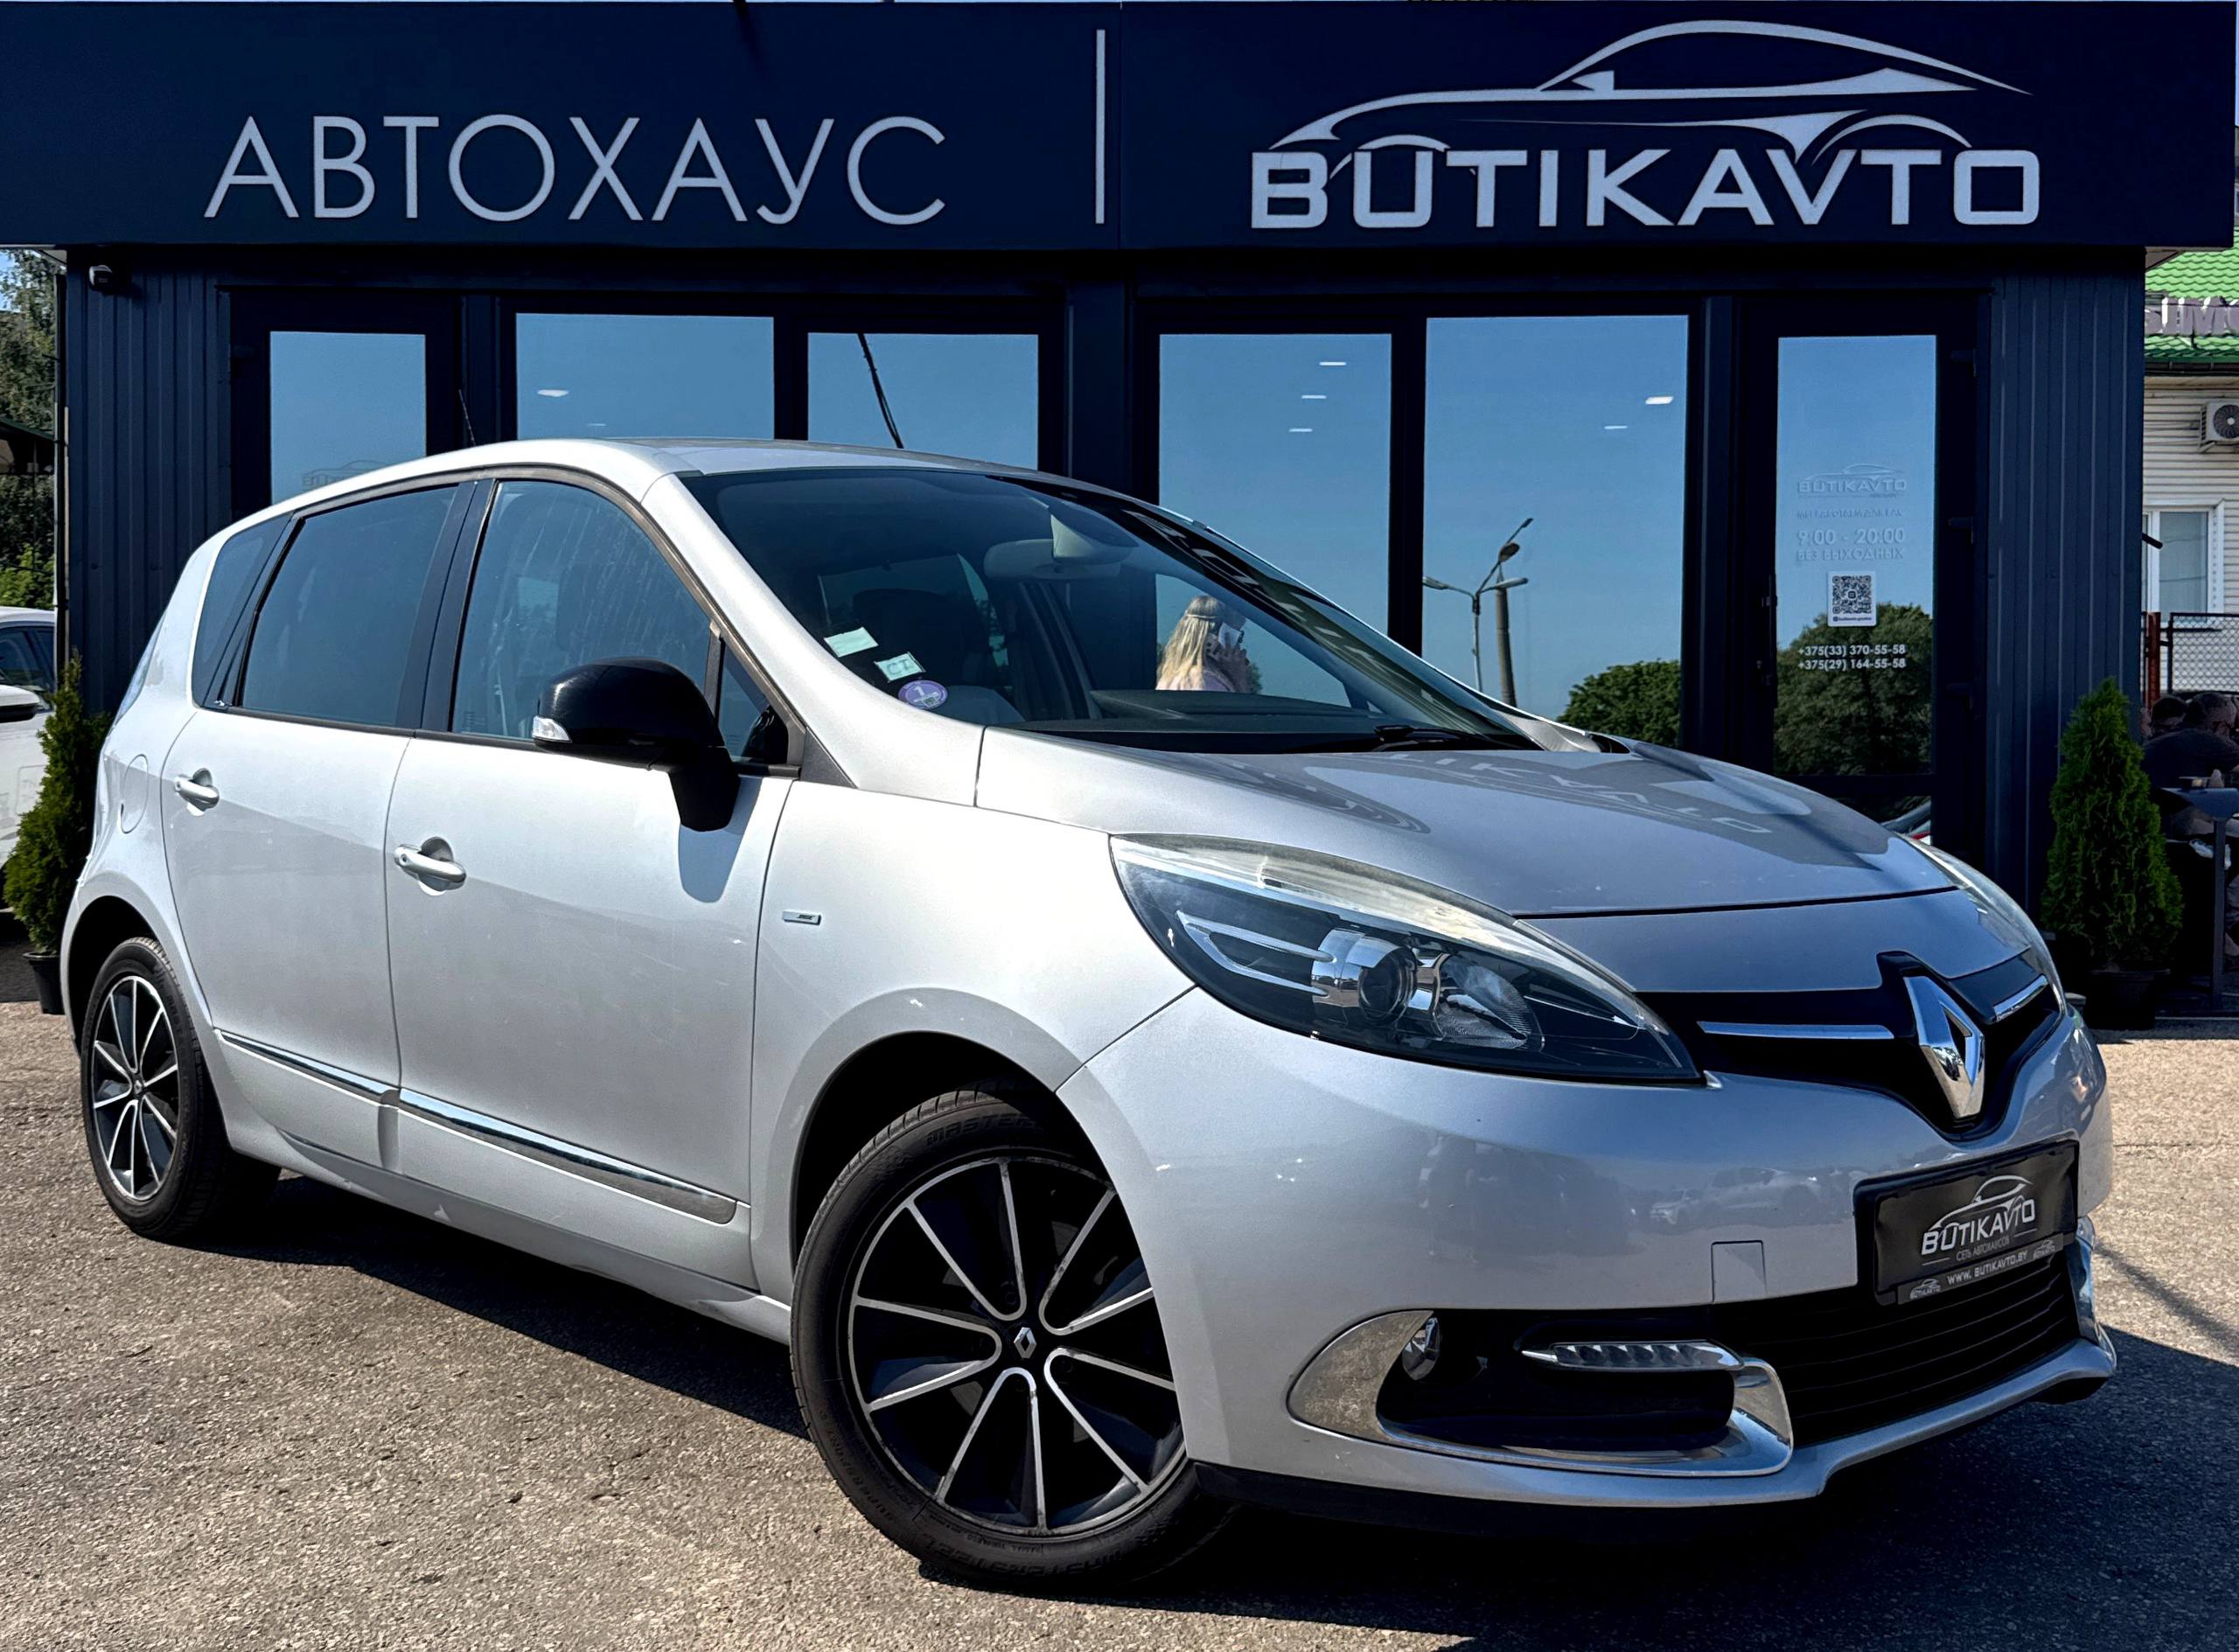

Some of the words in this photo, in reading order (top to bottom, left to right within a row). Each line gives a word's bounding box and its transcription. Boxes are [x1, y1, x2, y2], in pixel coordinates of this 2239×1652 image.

[204, 113, 947, 226] АВТОХАУС
[1251, 148, 2040, 229] BUTIKAVTO
[1797, 479, 1908, 493] BUTIKAVTO
[1797, 528, 1835, 546] 9:00
[1855, 526, 1905, 545] 20:00
[1799, 645, 1846, 658] +375(33)
[1850, 644, 1906, 655] 370-55-58
[1799, 659, 1846, 672] +375(29)
[1851, 658, 1906, 669] 164-55-58
[1922, 1199, 2036, 1255] BUTIKAVTO
[1974, 1250, 2027, 1277] BUTIKAVTO.BY
